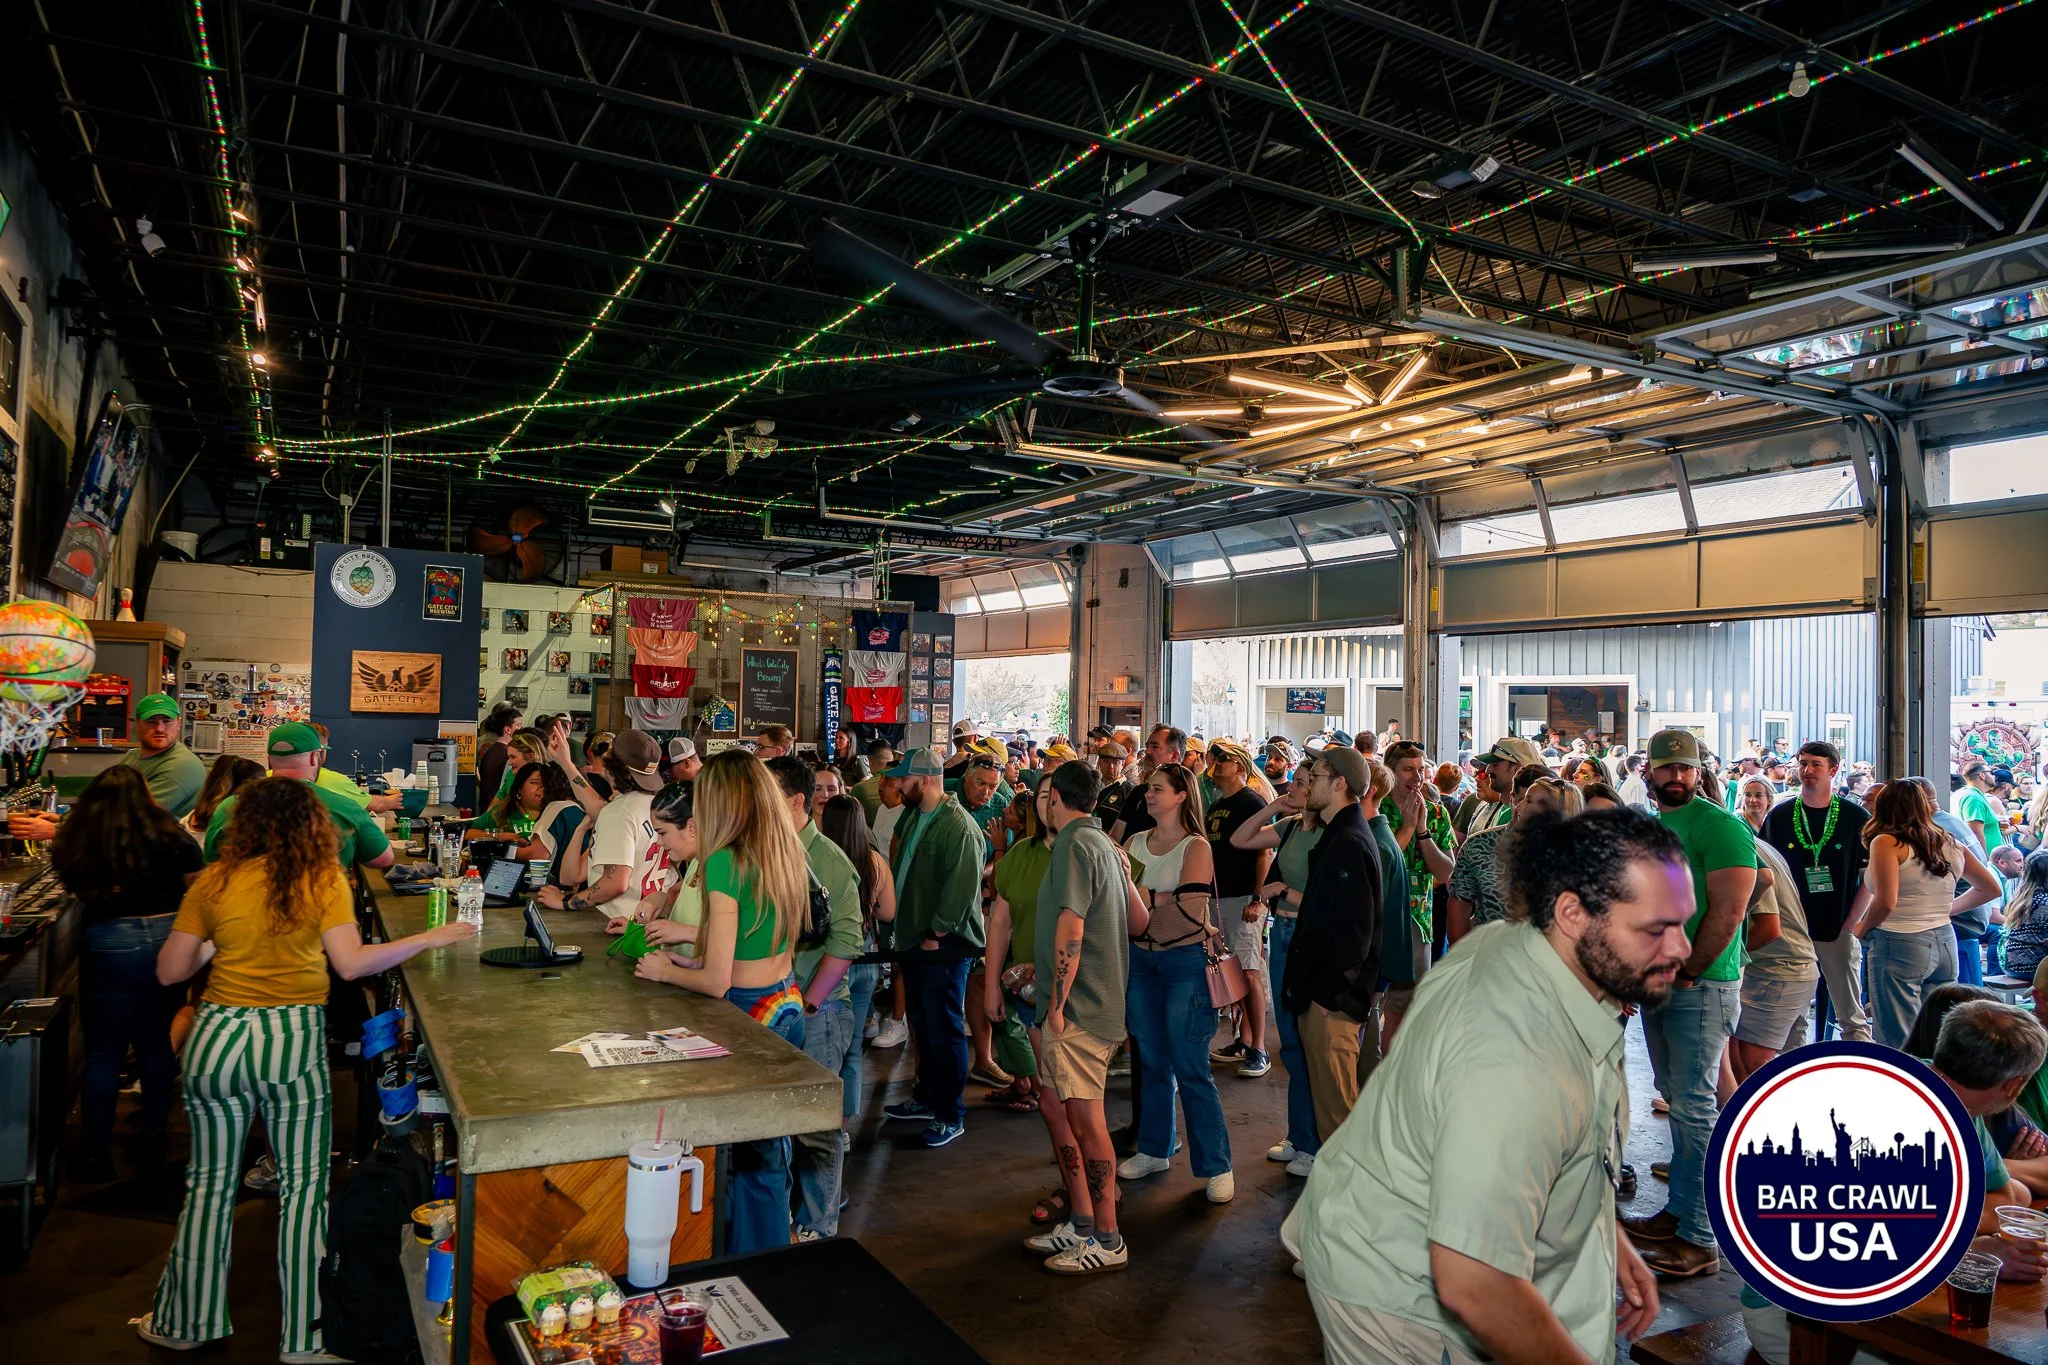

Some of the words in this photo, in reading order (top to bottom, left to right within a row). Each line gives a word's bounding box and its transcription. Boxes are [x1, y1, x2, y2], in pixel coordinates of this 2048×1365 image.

[364, 695, 395, 704] GATE
[398, 695, 426, 705] CITY
[829, 686, 839, 718] GATE
